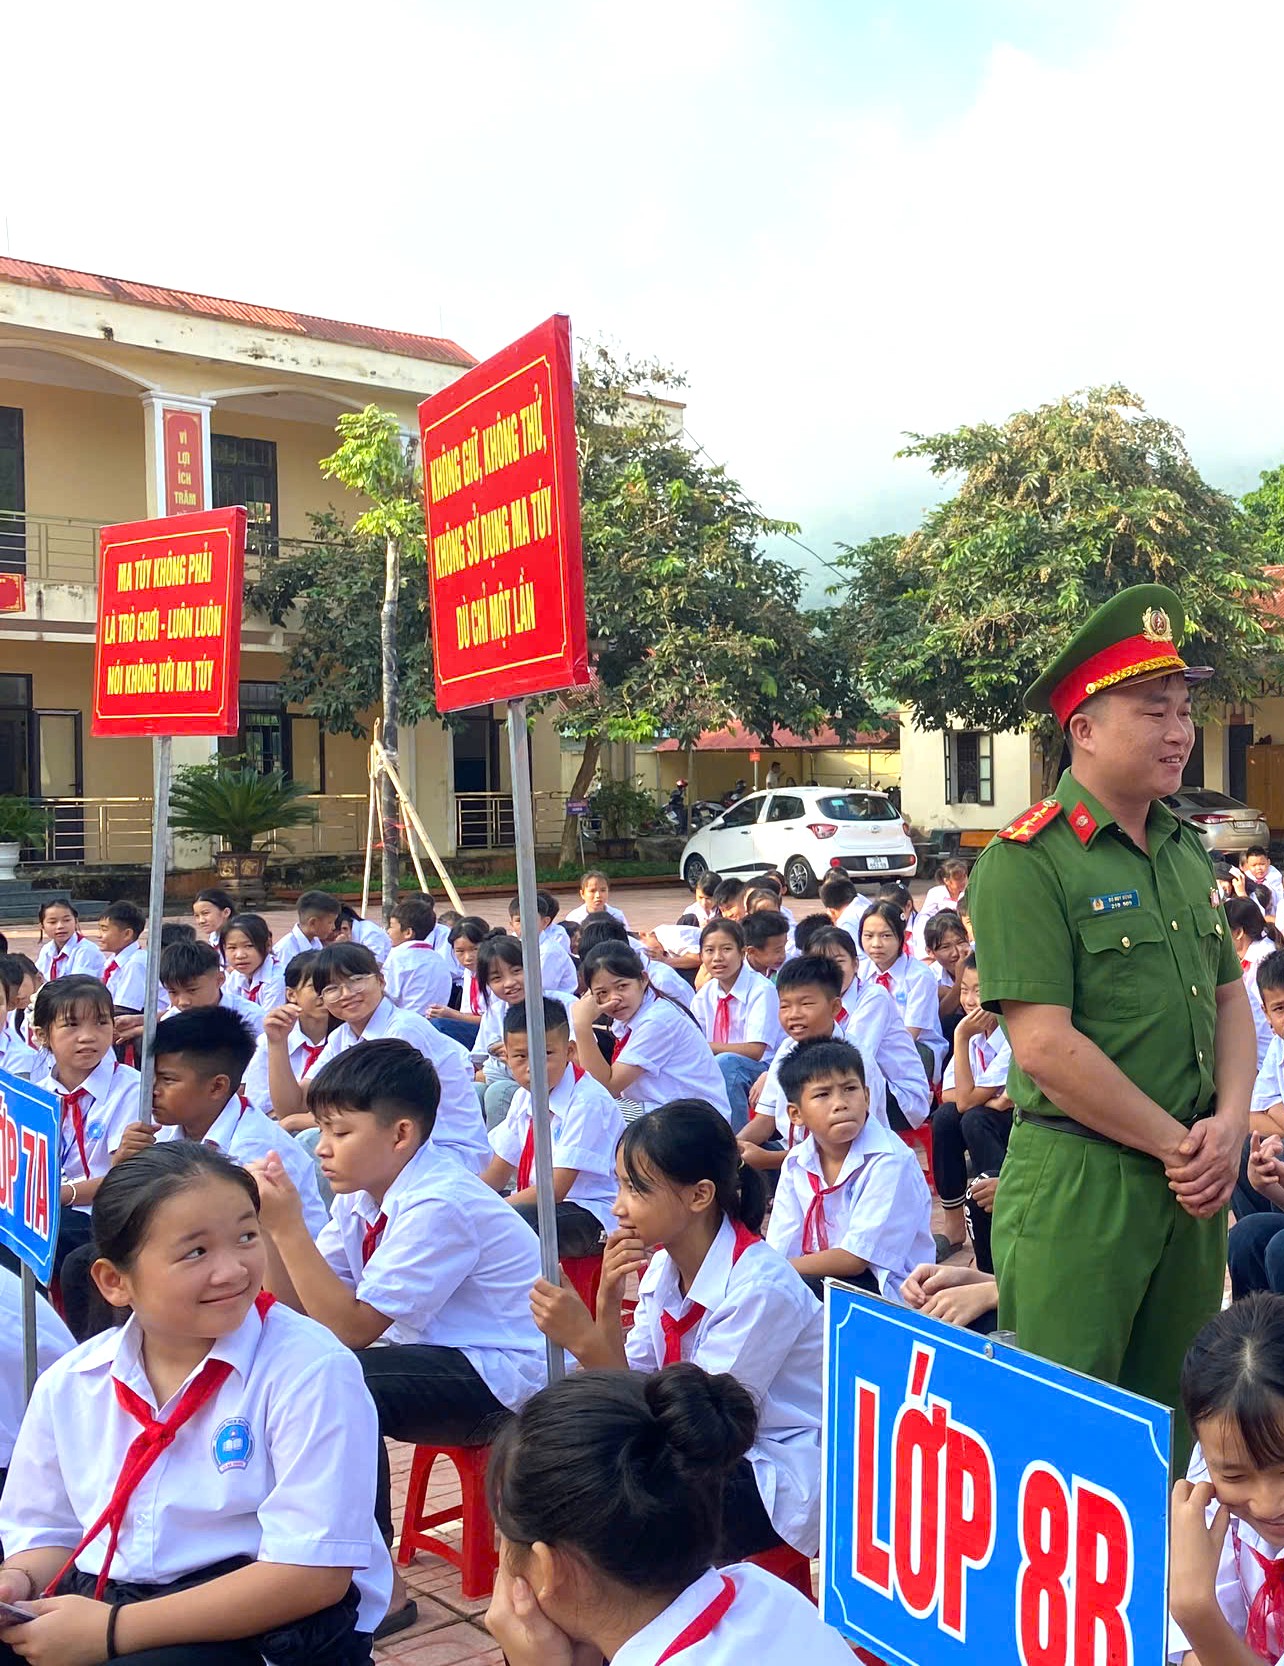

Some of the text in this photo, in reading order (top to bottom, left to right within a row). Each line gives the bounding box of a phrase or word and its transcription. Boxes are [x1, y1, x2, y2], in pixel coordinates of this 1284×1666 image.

[177, 451, 191, 468] LỢI
[179, 429, 188, 445] VÌ
[430, 444, 462, 504] KHÔNG
[482, 411, 520, 476] KHÔNG
[520, 383, 547, 457] THỬ,
[174, 490, 197, 506] TRĂM
[178, 468, 192, 485] ÍCH
[433, 478, 552, 580] KHÔNG SỬ DỤNG MA TÚY
[117, 541, 213, 592] MA TÚY KHÔNG PHẢI
[104, 609, 116, 644] LÀ
[118, 606, 135, 643] TRÒ
[137, 608, 160, 642] CHƠI
[167, 601, 193, 639] LUÔN
[194, 599, 222, 638] LUÔN
[456, 567, 536, 650] DÙ CHỈ MỘT LẦN
[107, 653, 214, 695] NÓI KHÔNG VỚI MA TÚY
[21, 1125, 48, 1242] 7A
[852, 1339, 997, 1644] LỚP
